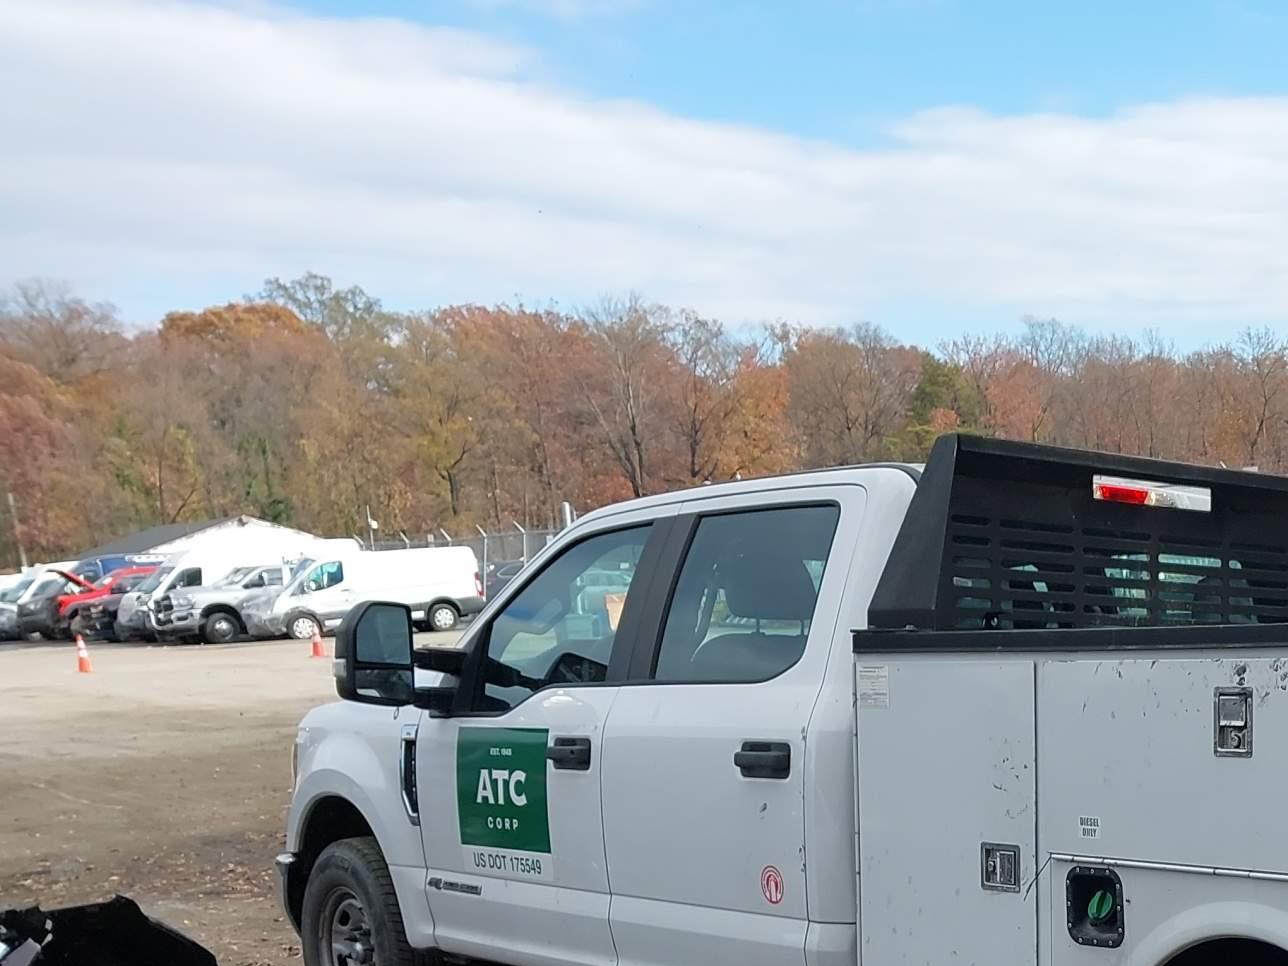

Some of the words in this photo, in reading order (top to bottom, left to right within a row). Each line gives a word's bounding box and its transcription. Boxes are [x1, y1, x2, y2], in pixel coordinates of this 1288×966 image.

[476, 768, 527, 806] ATC
[487, 816, 519, 830] CORP
[1080, 816, 1099, 827] DIESEL
[1082, 828, 1096, 838] ONLY
[473, 852, 487, 868] US
[488, 854, 506, 870] DOT
[510, 856, 541, 874] 175549
